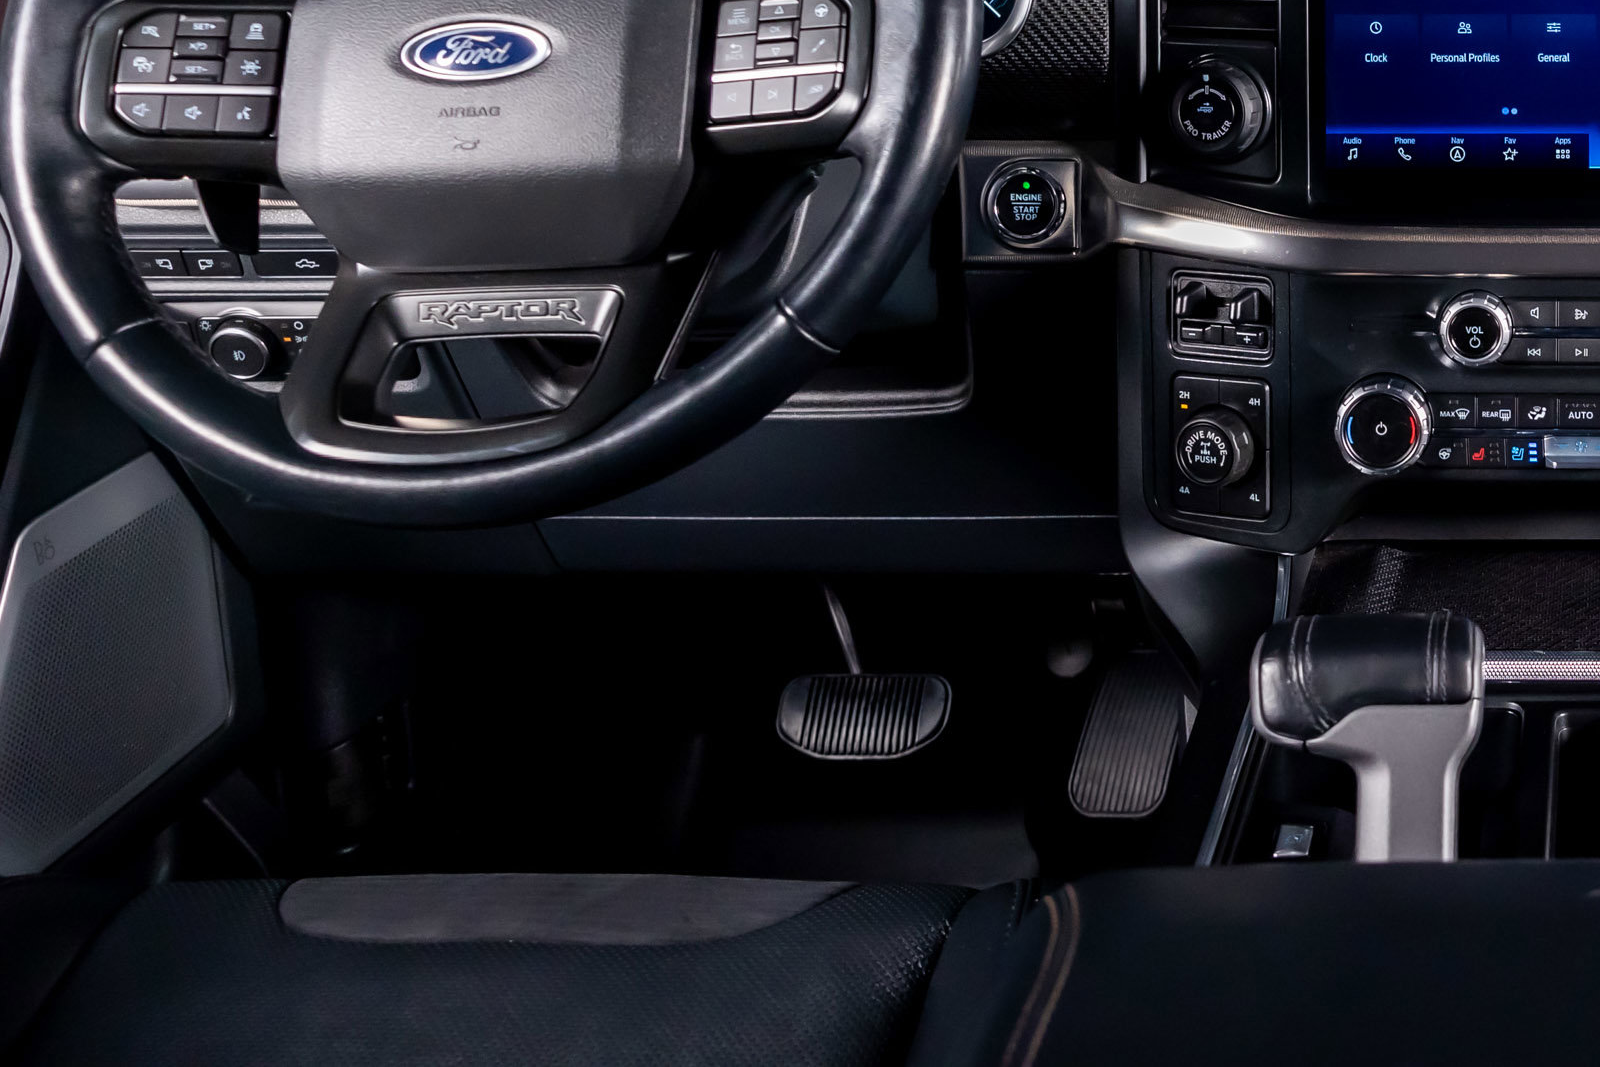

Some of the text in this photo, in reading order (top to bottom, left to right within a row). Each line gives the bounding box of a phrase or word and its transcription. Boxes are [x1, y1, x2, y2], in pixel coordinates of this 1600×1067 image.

[436, 35, 513, 67] Ford
[1364, 52, 1388, 63] Clock
[1430, 52, 1501, 63] Personal Profiles
[1537, 52, 1571, 63] General
[437, 107, 501, 119] AIRBAG
[1183, 120, 1232, 140] PRO TRAILER
[1342, 136, 1363, 145] Audio
[1394, 136, 1416, 145] Phone
[1450, 136, 1465, 145] Nav
[1503, 136, 1517, 145] Fav
[1554, 136, 1572, 147] Apps
[1010, 193, 1043, 202] ENGINE
[1012, 205, 1040, 214] START
[1014, 213, 1038, 221] STOP
[419, 299, 586, 330] RAPTOR
[1465, 325, 1484, 334] VOL
[1178, 390, 1190, 400] 2H
[1248, 397, 1261, 407] 4H
[1439, 409, 1455, 418] MAX
[1481, 409, 1499, 418] REAR
[1568, 411, 1594, 420] AUTO
[1185, 430, 1228, 456] DRIVE MODE
[1194, 454, 1217, 464] PUSH
[1178, 485, 1191, 495] 4A
[1249, 493, 1260, 502] 4L
